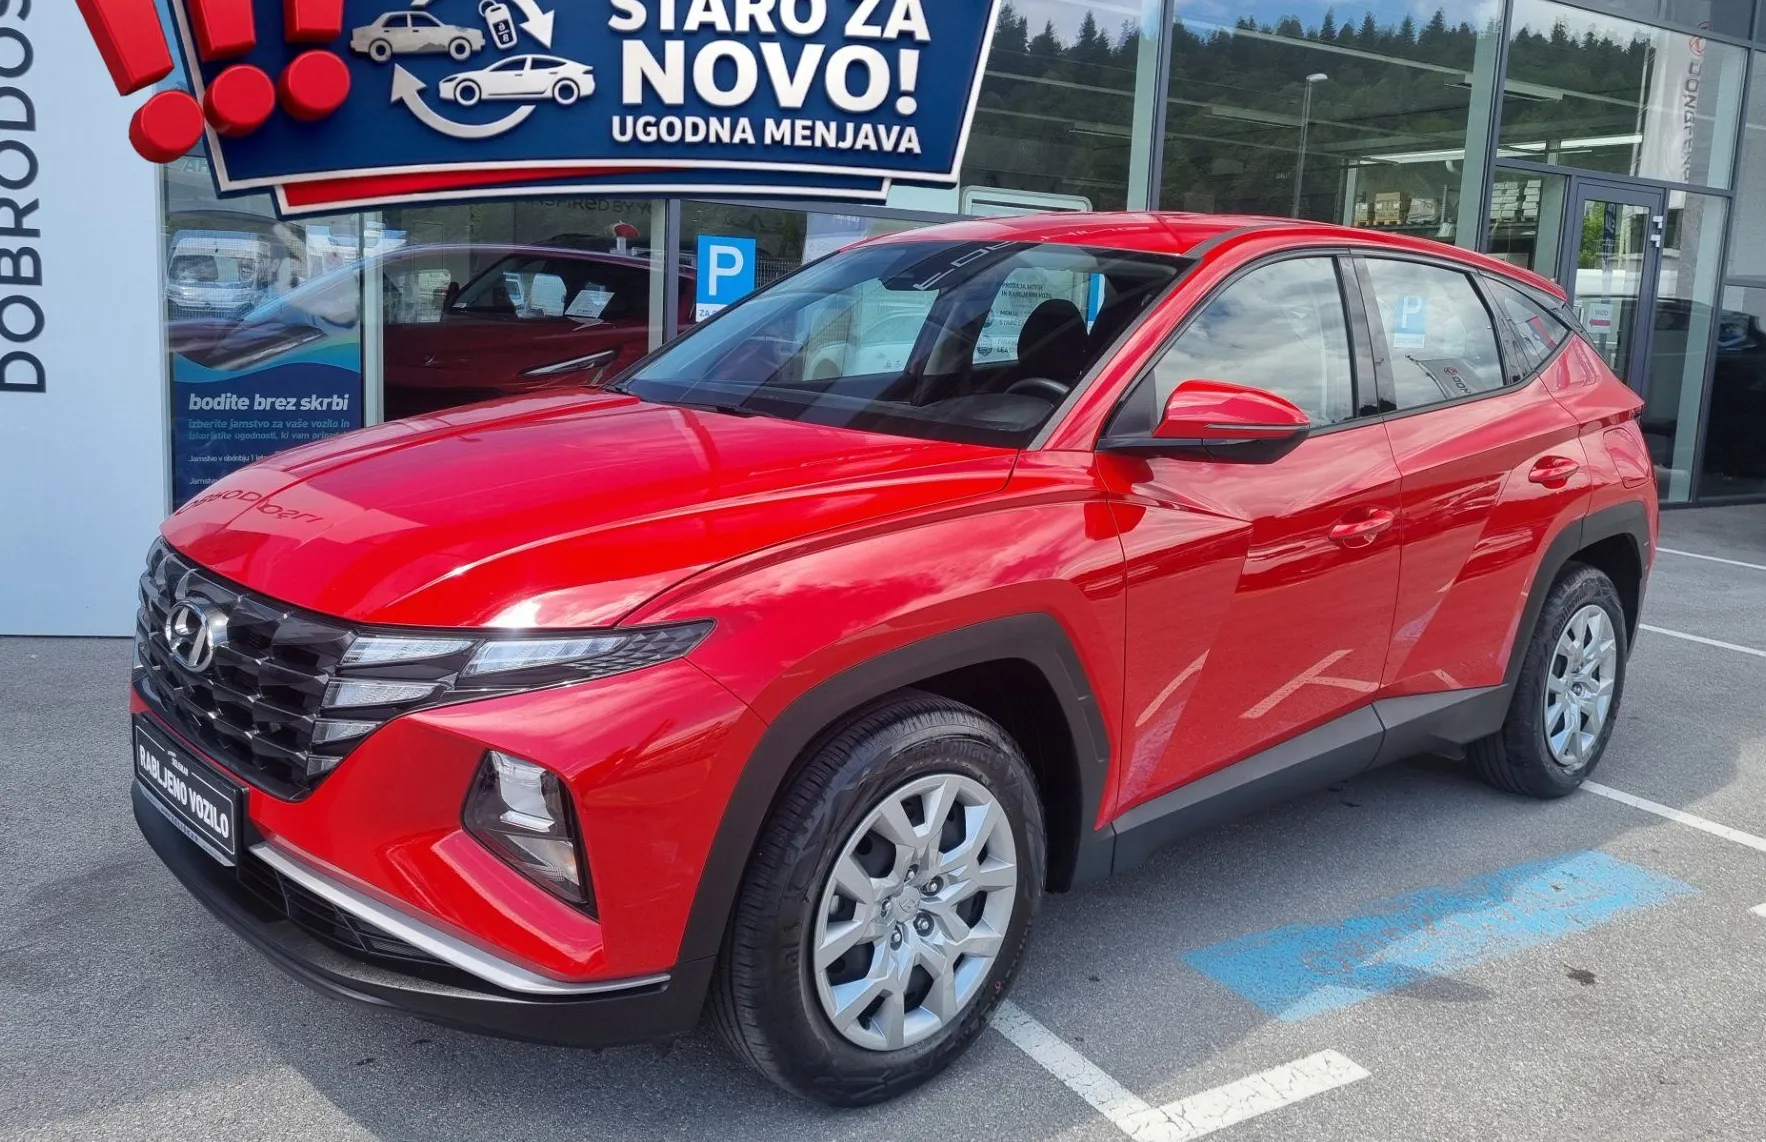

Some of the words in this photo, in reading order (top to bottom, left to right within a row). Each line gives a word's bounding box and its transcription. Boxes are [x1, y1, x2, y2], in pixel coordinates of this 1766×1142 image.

[708, 245, 744, 296] P
[188, 393, 250, 411] bodite
[253, 393, 297, 411] brez
[299, 393, 350, 411] skrbi
[188, 418, 227, 429] izberite
[229, 418, 270, 431] jamstvo
[271, 421, 283, 429] za
[286, 419, 307, 429] vaše
[311, 419, 339, 429] vozilo
[341, 419, 350, 428] in
[139, 744, 188, 806] RABLJENO
[188, 787, 230, 839] VOZILO
